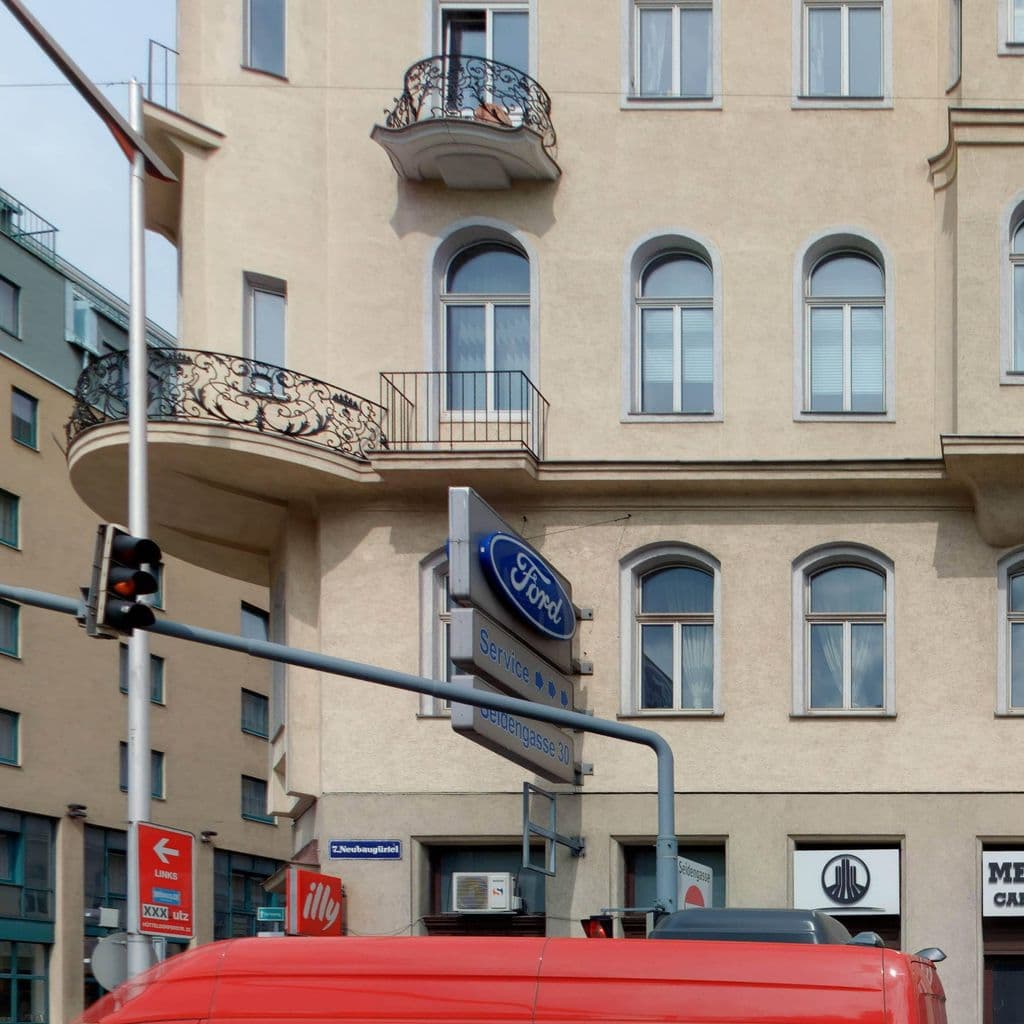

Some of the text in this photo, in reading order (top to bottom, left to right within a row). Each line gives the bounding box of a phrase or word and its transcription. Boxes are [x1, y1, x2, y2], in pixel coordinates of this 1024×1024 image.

[510, 551, 562, 625] Ford
[479, 628, 530, 684] Service
[558, 741, 570, 766] 30
[154, 869, 178, 880] LINKS
[144, 905, 167, 918] XXX
[303, 881, 340, 931] illy
